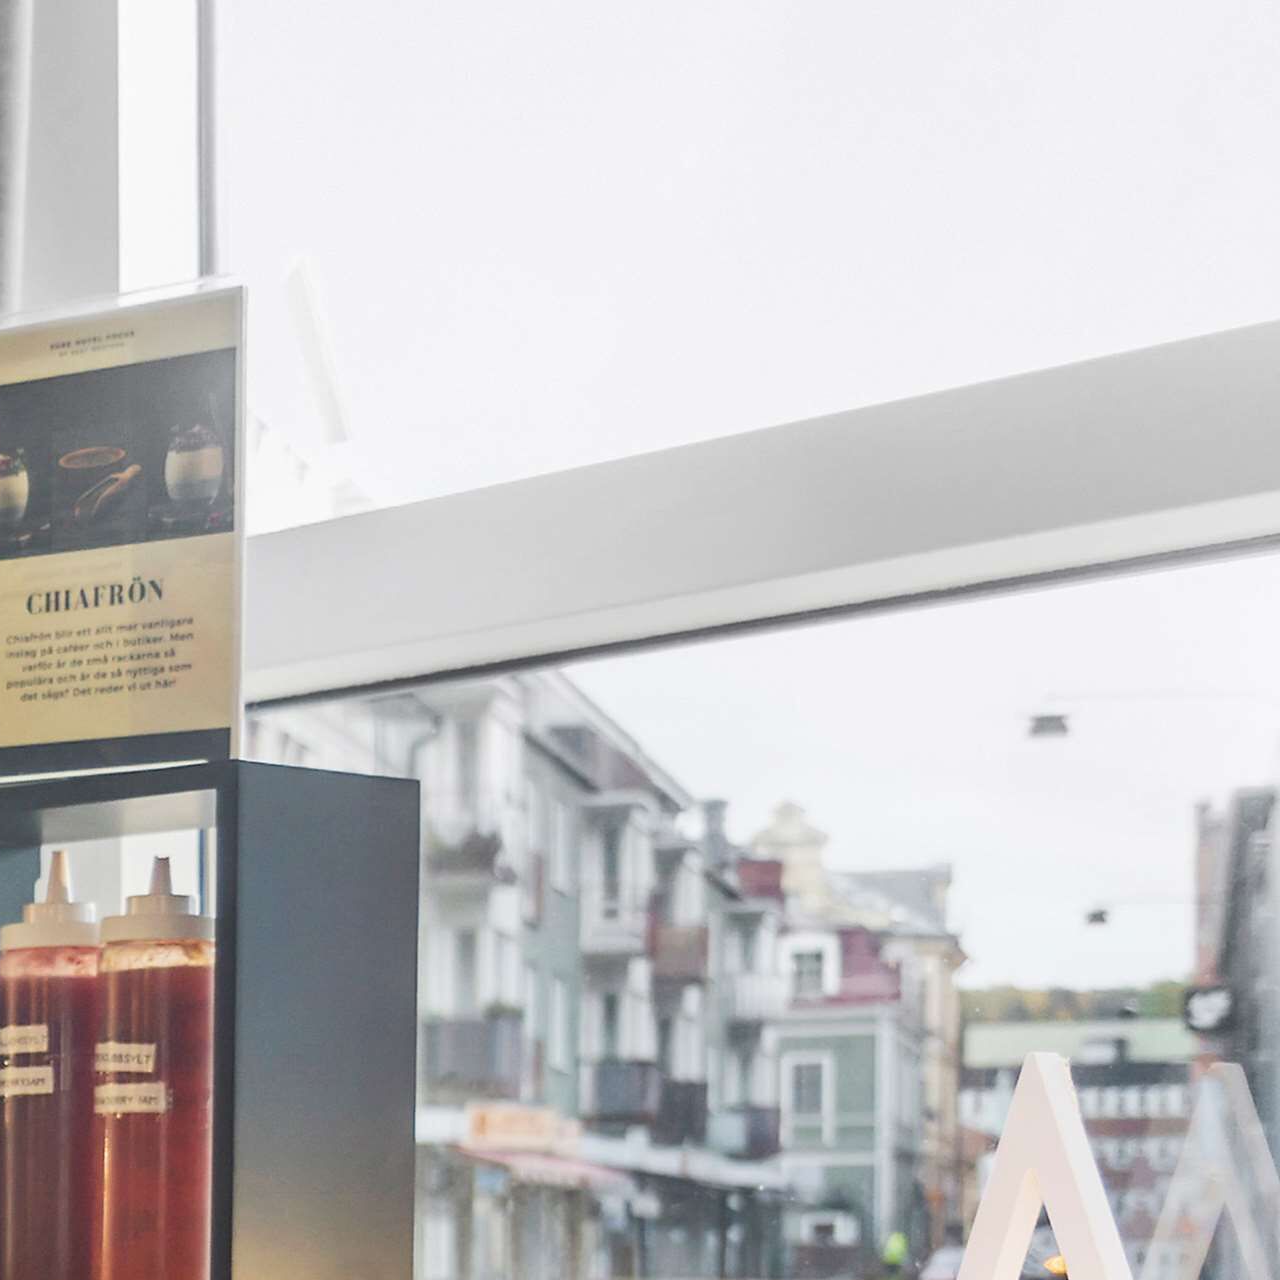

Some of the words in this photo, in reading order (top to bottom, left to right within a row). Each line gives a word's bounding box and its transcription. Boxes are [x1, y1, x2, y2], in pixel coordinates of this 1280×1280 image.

[26, 576, 164, 615] CHIAFRÖN
[6, 632, 52, 645] Chiafrön
[55, 629, 73, 640] blir
[76, 627, 91, 637] ett
[142, 616, 194, 630] vanligare
[6, 648, 37, 660] inslag
[40, 646, 53, 657] på
[93, 639, 113, 649] och
[169, 631, 194, 642] Men
[22, 661, 53, 673] varför
[56, 659, 67, 668] är
[69, 657, 84, 667] de
[86, 655, 109, 666] små
[164, 648, 176, 658] så
[6, 676, 54, 690] populära
[57, 673, 77, 684] och
[80, 671, 91, 681] är
[93, 670, 108, 680] de
[110, 668, 123, 678] så
[126, 664, 165, 679] nyttiga
[169, 663, 193, 672] som
[20, 691, 38, 702] det
[73, 686, 91, 697] Det
[94, 683, 124, 695] reder
[127, 682, 137, 692] vi
[139, 681, 152, 690] ut
